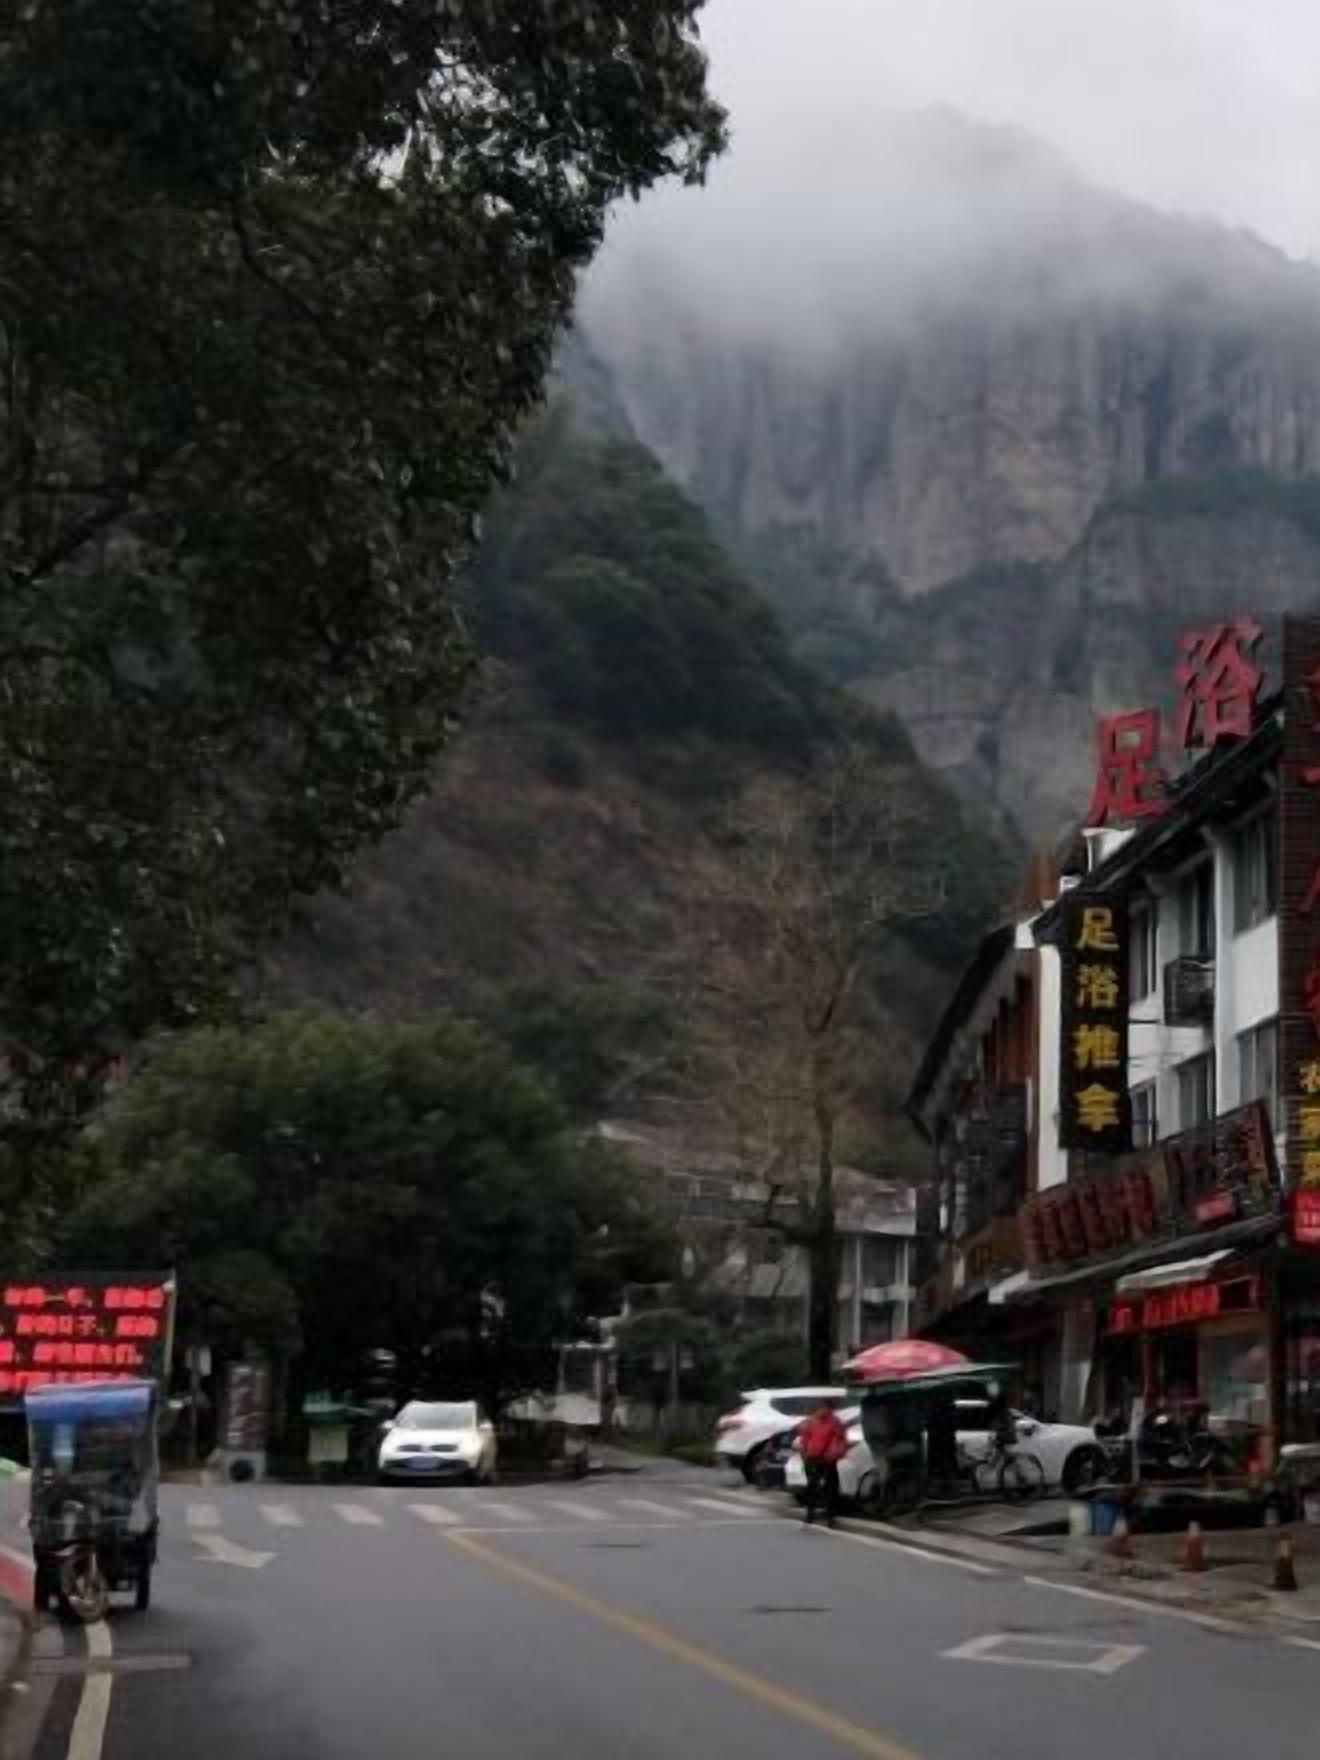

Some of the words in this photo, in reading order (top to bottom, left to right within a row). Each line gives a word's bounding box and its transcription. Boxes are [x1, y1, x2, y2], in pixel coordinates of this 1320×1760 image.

[1087, 613, 1265, 827] 足浴
[1070, 906, 1120, 1134] 足浴推拿
